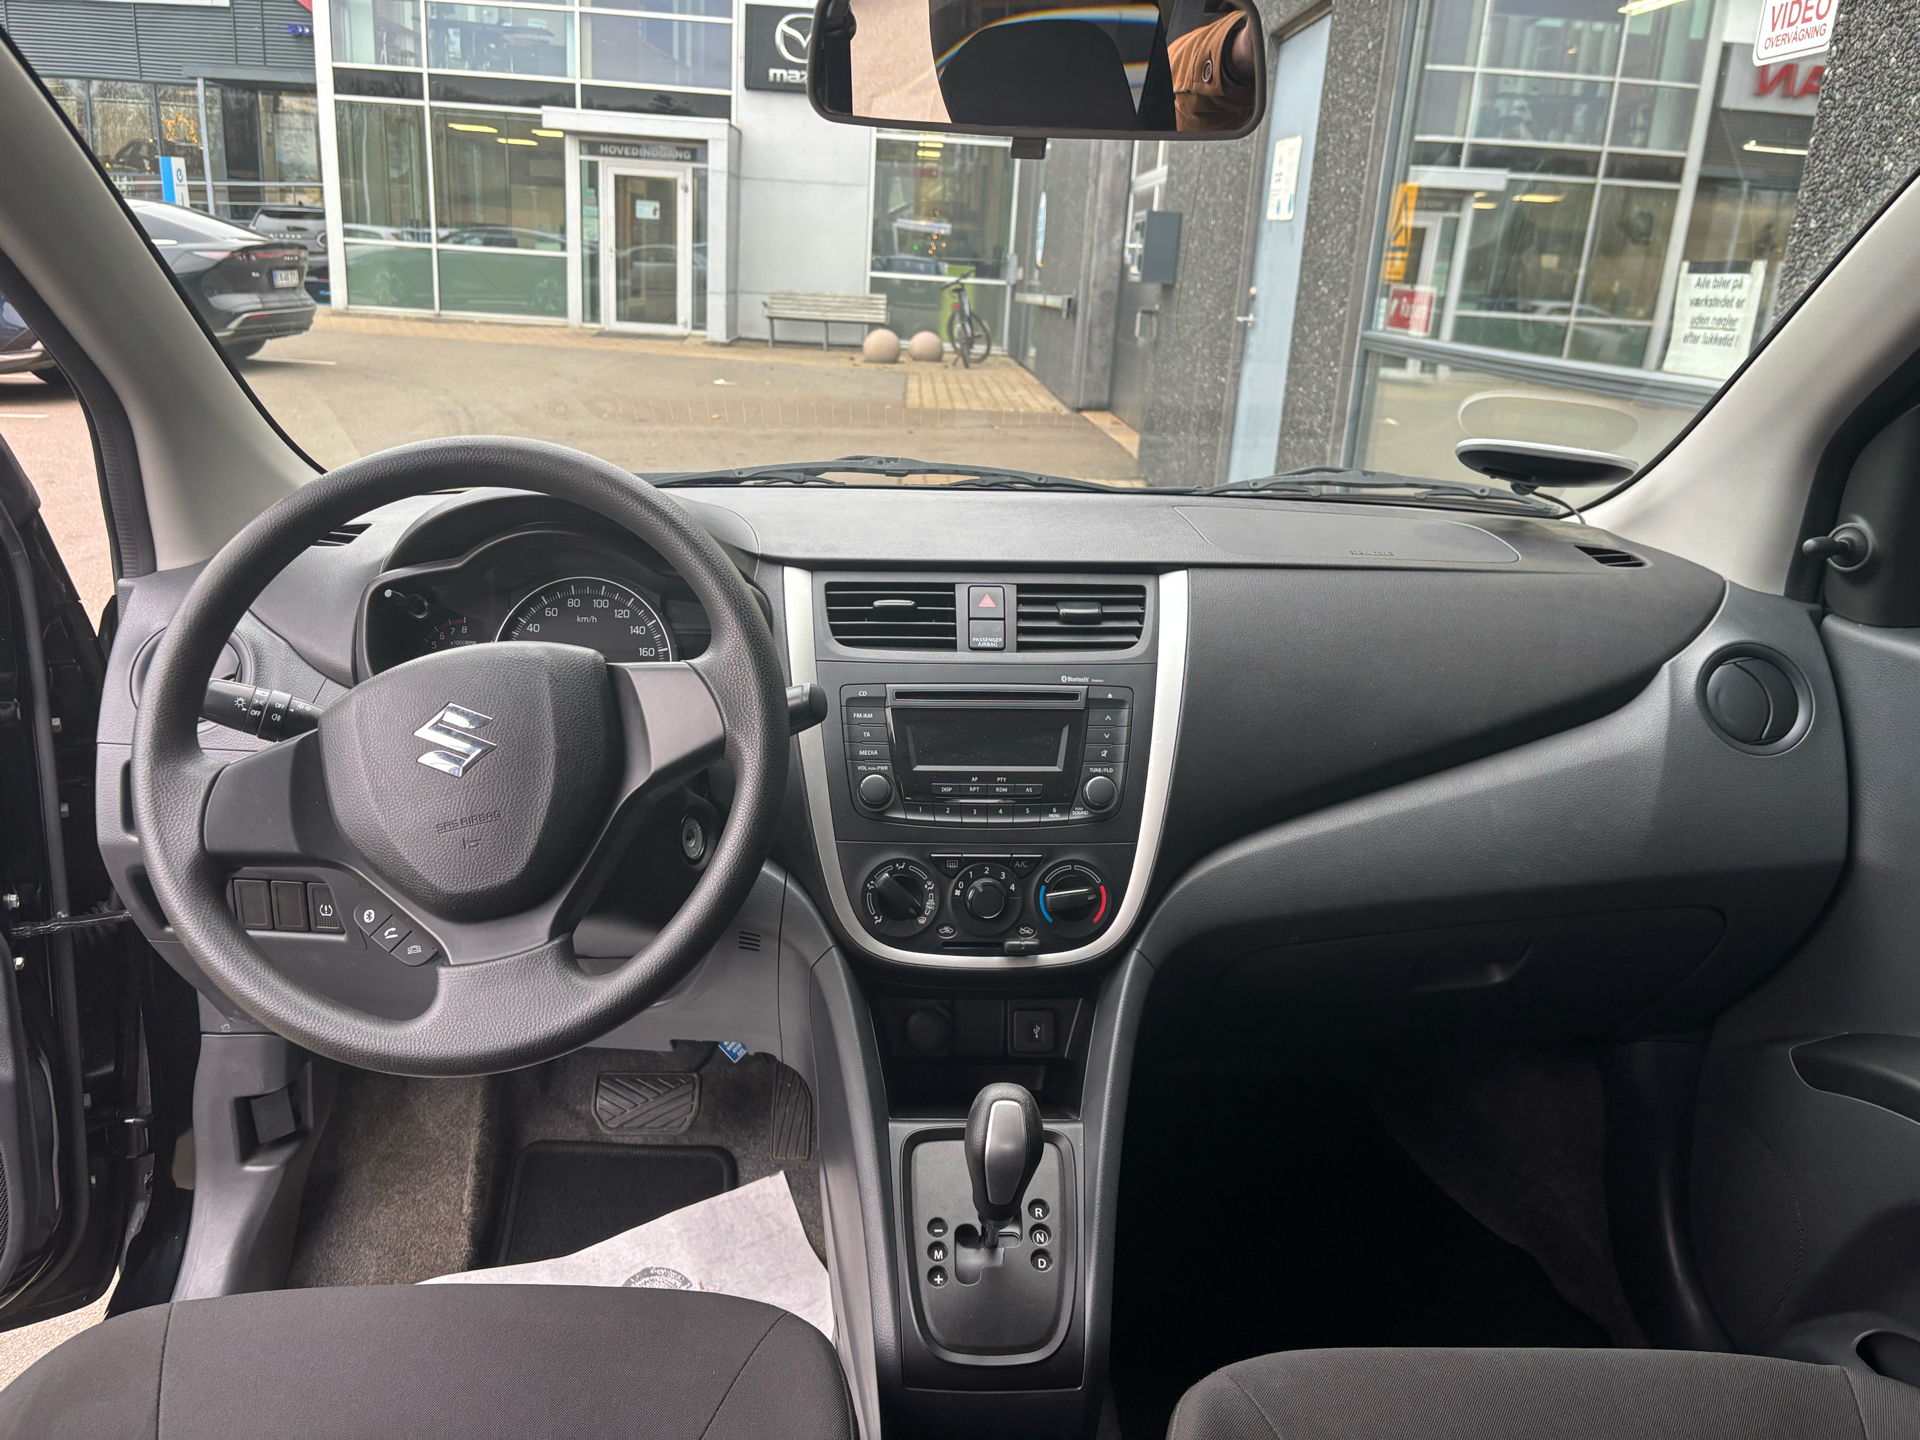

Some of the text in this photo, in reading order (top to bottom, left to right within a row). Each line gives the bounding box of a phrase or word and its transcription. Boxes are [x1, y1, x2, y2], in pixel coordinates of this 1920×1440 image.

[1771, 0, 1832, 32] VIDEO
[1764, 23, 1827, 50] OVERVÅGNING
[1735, 298, 1746, 309] er
[567, 598, 581, 608] 80
[593, 599, 609, 608] 100
[545, 607, 558, 617] 60
[614, 609, 630, 619] 120
[576, 615, 598, 623] km/h
[450, 627, 456, 635] 7
[461, 625, 468, 633] 8
[526, 623, 540, 633] 40
[630, 625, 646, 635] 140
[439, 632, 445, 640] 6
[431, 641, 437, 649] 5
[639, 647, 655, 657] 160
[969, 871, 973, 879] 1
[984, 866, 990, 874] 2
[1000, 871, 1006, 880] 3
[958, 881, 964, 889] 0
[1009, 883, 1015, 891] 4
[1034, 1207, 1043, 1218] R
[1036, 1233, 1045, 1243] N
[934, 1250, 944, 1260] M
[1037, 1258, 1047, 1268] D
